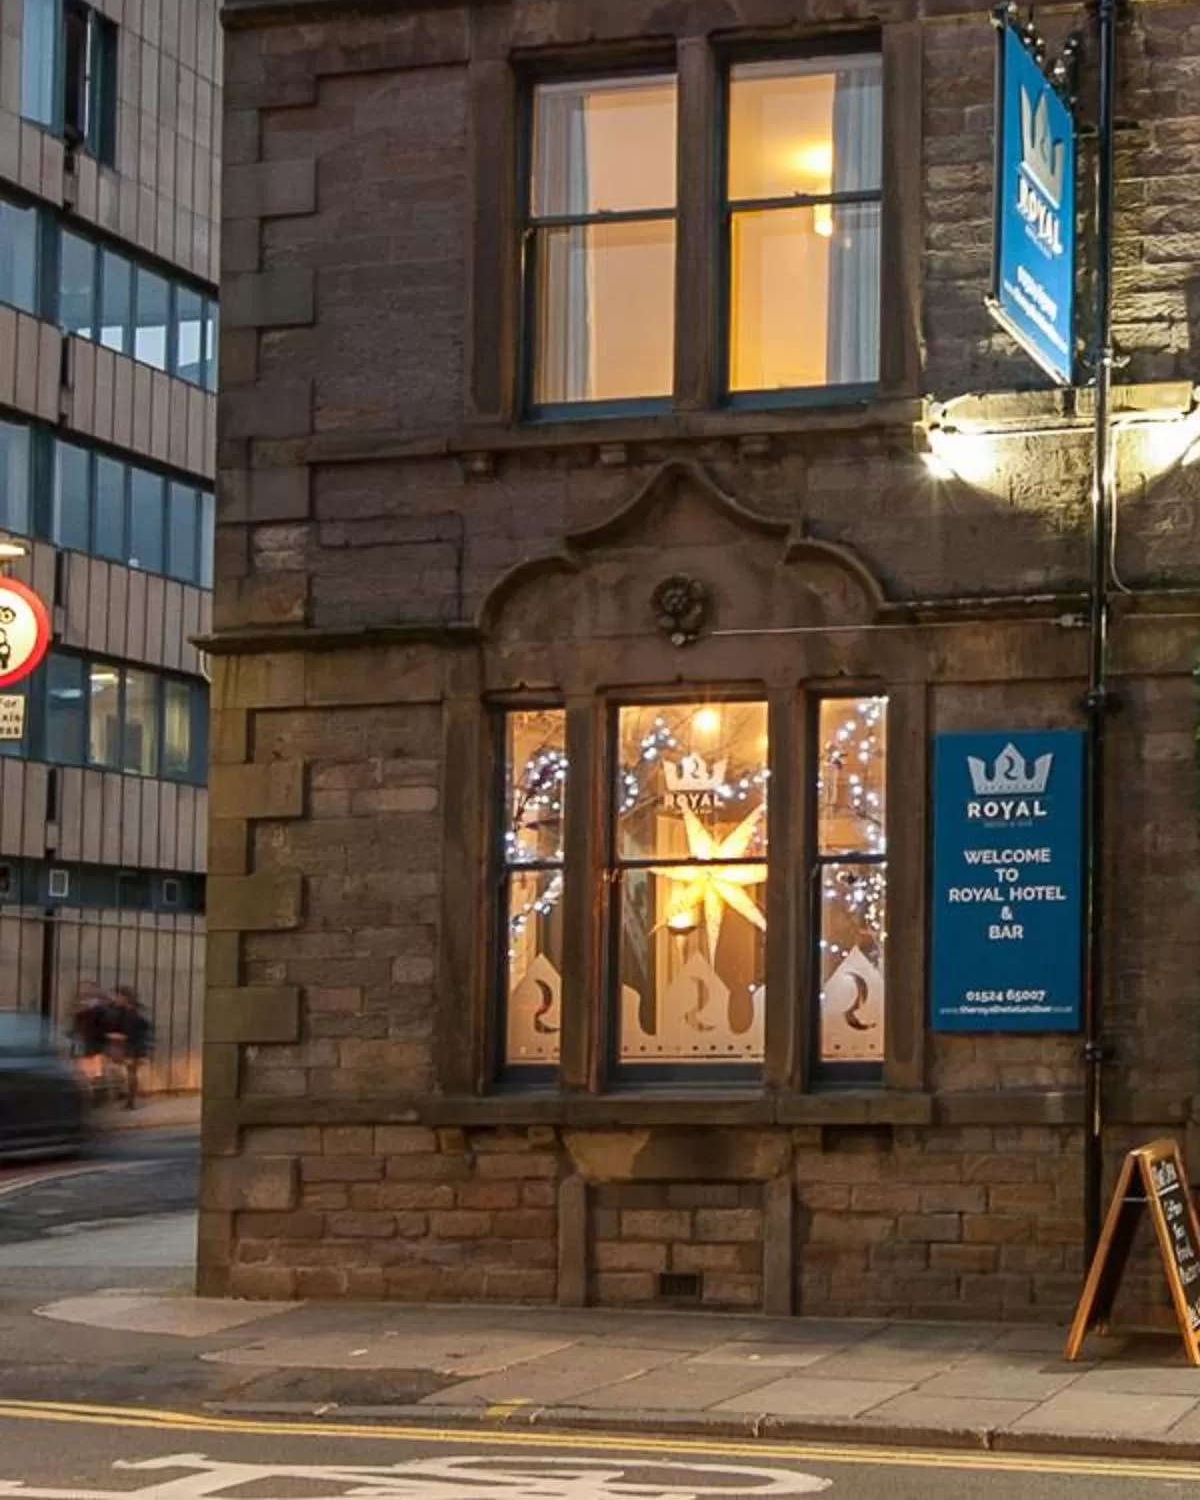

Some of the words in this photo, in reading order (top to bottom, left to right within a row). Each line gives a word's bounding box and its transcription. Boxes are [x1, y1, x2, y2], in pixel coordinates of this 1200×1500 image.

[663, 793, 725, 809] ROYAL
[967, 800, 1048, 820] ROYAL
[963, 847, 1052, 865] WELCOME
[994, 867, 1019, 883] TO
[948, 887, 1005, 903] ROYAL
[1009, 885, 1067, 901] HOTEL
[1001, 905, 1013, 921] &
[988, 925, 1024, 940] BAR
